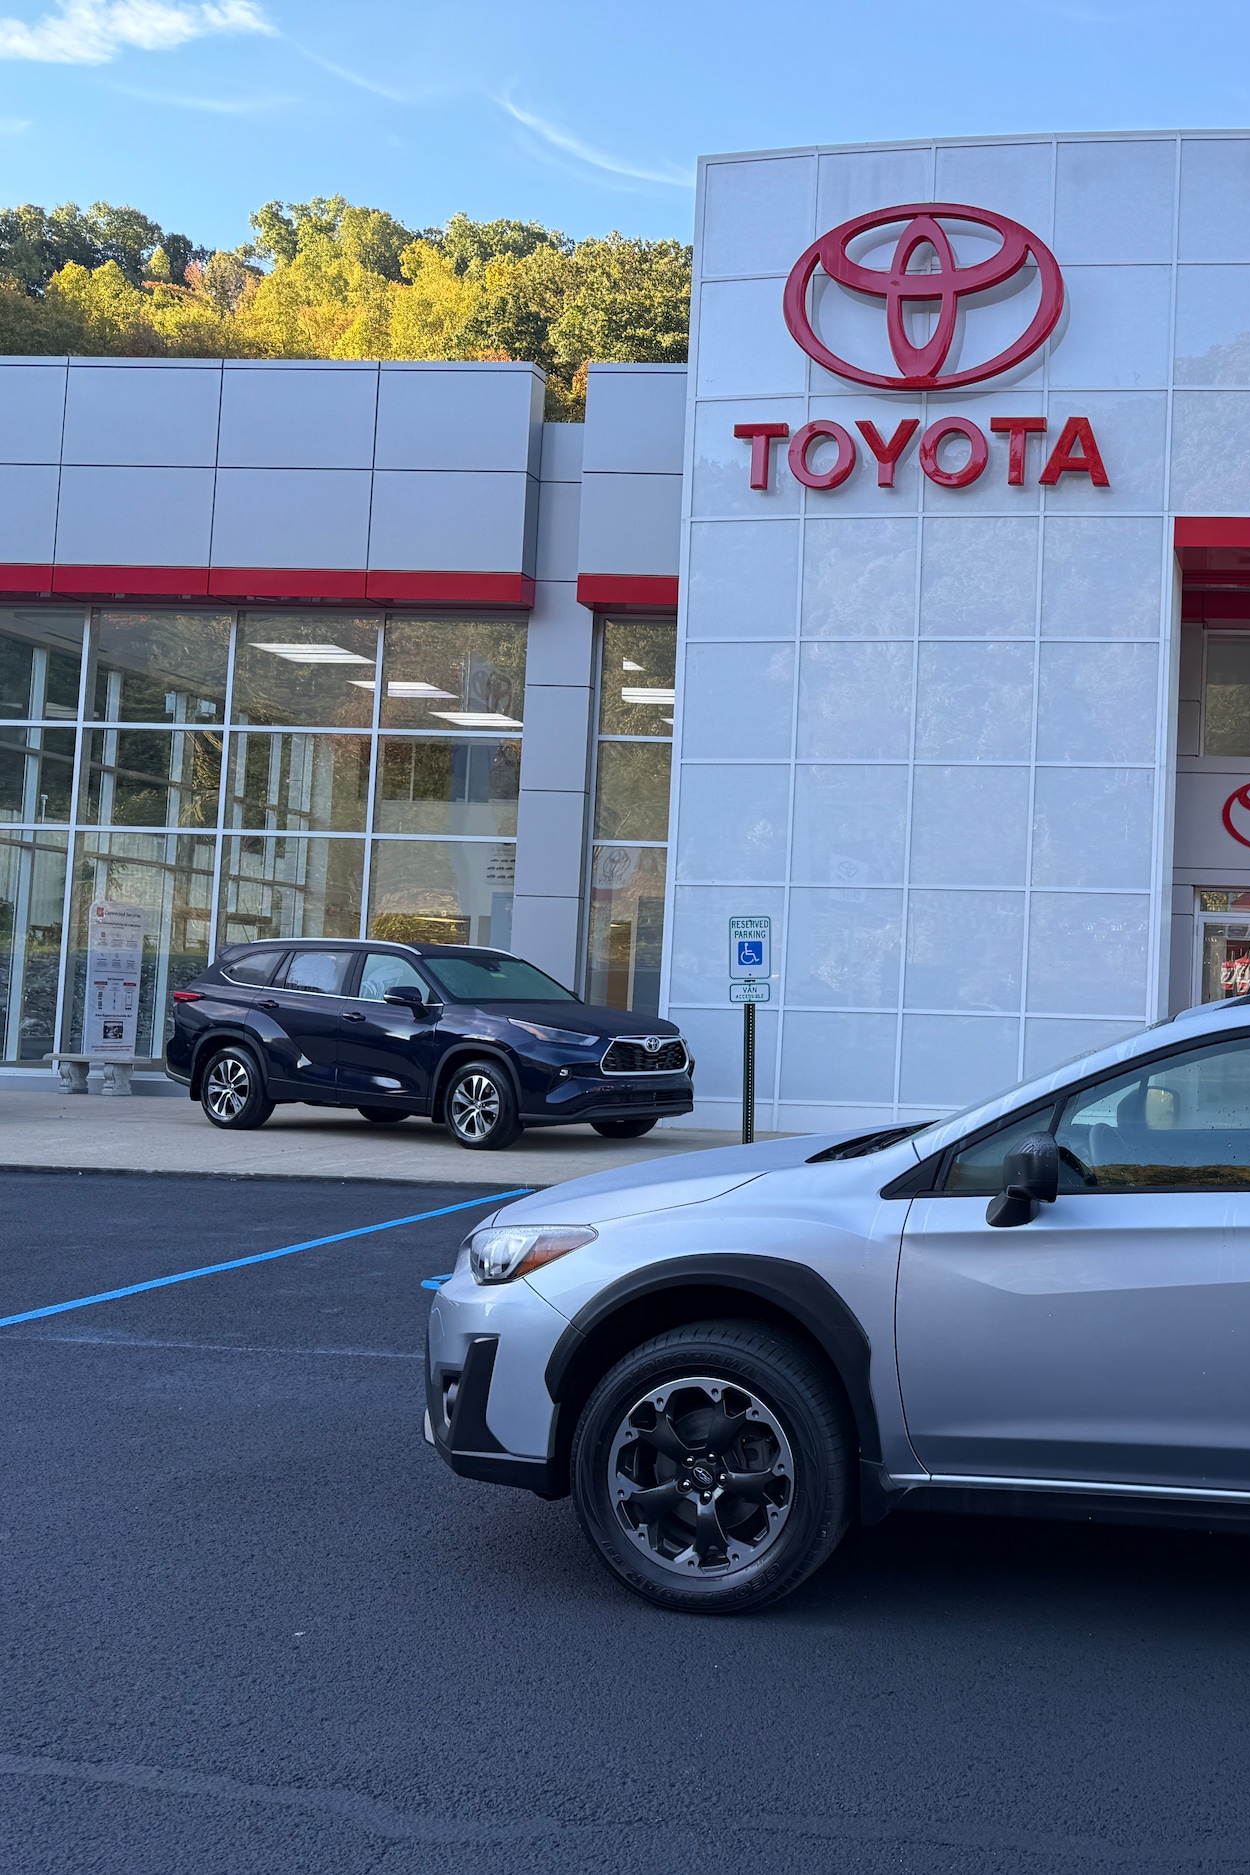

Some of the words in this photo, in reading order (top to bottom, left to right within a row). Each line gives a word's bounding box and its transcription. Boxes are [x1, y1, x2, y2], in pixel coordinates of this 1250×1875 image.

[734, 416, 1110, 491] TOYOTA
[731, 919, 769, 929] RESERVED
[734, 930, 766, 939] PARKING
[624, 1350, 760, 1384] YOKOHAMA
[625, 1562, 783, 1606] GEOLANDAR
